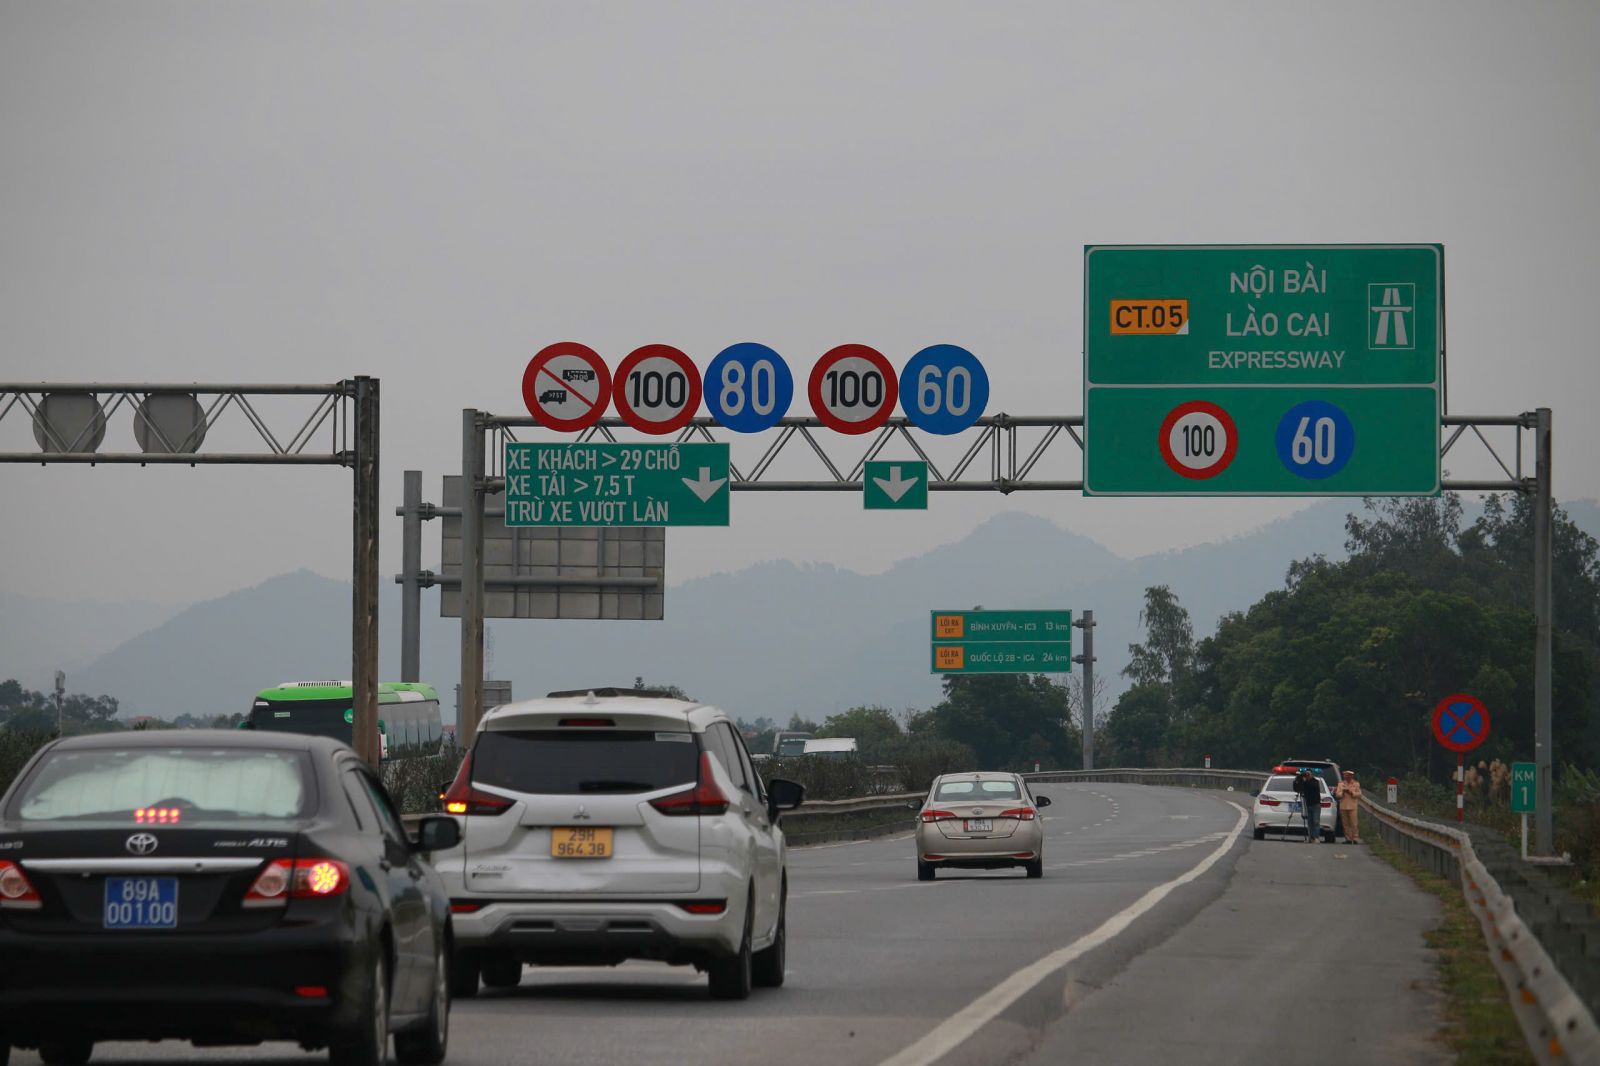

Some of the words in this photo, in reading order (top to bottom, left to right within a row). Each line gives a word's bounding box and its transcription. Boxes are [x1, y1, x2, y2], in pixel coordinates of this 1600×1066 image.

[1230, 264, 1274, 299] NỘI
[1284, 261, 1326, 294] BÀI
[1116, 306, 1182, 328] CT.05
[1226, 304, 1278, 336] LÀO
[1287, 312, 1330, 336] CAI
[1208, 351, 1346, 369] EXPRESSWAY
[630, 370, 686, 408] 100
[719, 359, 776, 416] 80
[826, 370, 882, 408] 100
[917, 364, 972, 416] 60
[1182, 425, 1215, 456] 100
[1292, 416, 1336, 465] 60
[508, 449, 530, 470] XE
[538, 444, 596, 470] KHÁCH
[620, 449, 642, 470] 29
[646, 443, 680, 470] CHỖ
[508, 476, 530, 496] XE
[538, 470, 566, 496] TẢI
[508, 496, 545, 522] TRỪ
[550, 502, 572, 522] XE
[579, 501, 626, 526] VƯỢT
[633, 496, 669, 522] LÀN
[970, 621, 990, 631] BÌNH
[991, 621, 1017, 631] XUYÊN
[1045, 622, 1054, 631] 13
[970, 652, 991, 662] QUỐC
[1042, 652, 1053, 662] 24
[1514, 770, 1534, 782] KM
[1520, 786, 1528, 806] 1
[122, 880, 160, 902] 89A
[108, 902, 174, 924] 001.00
